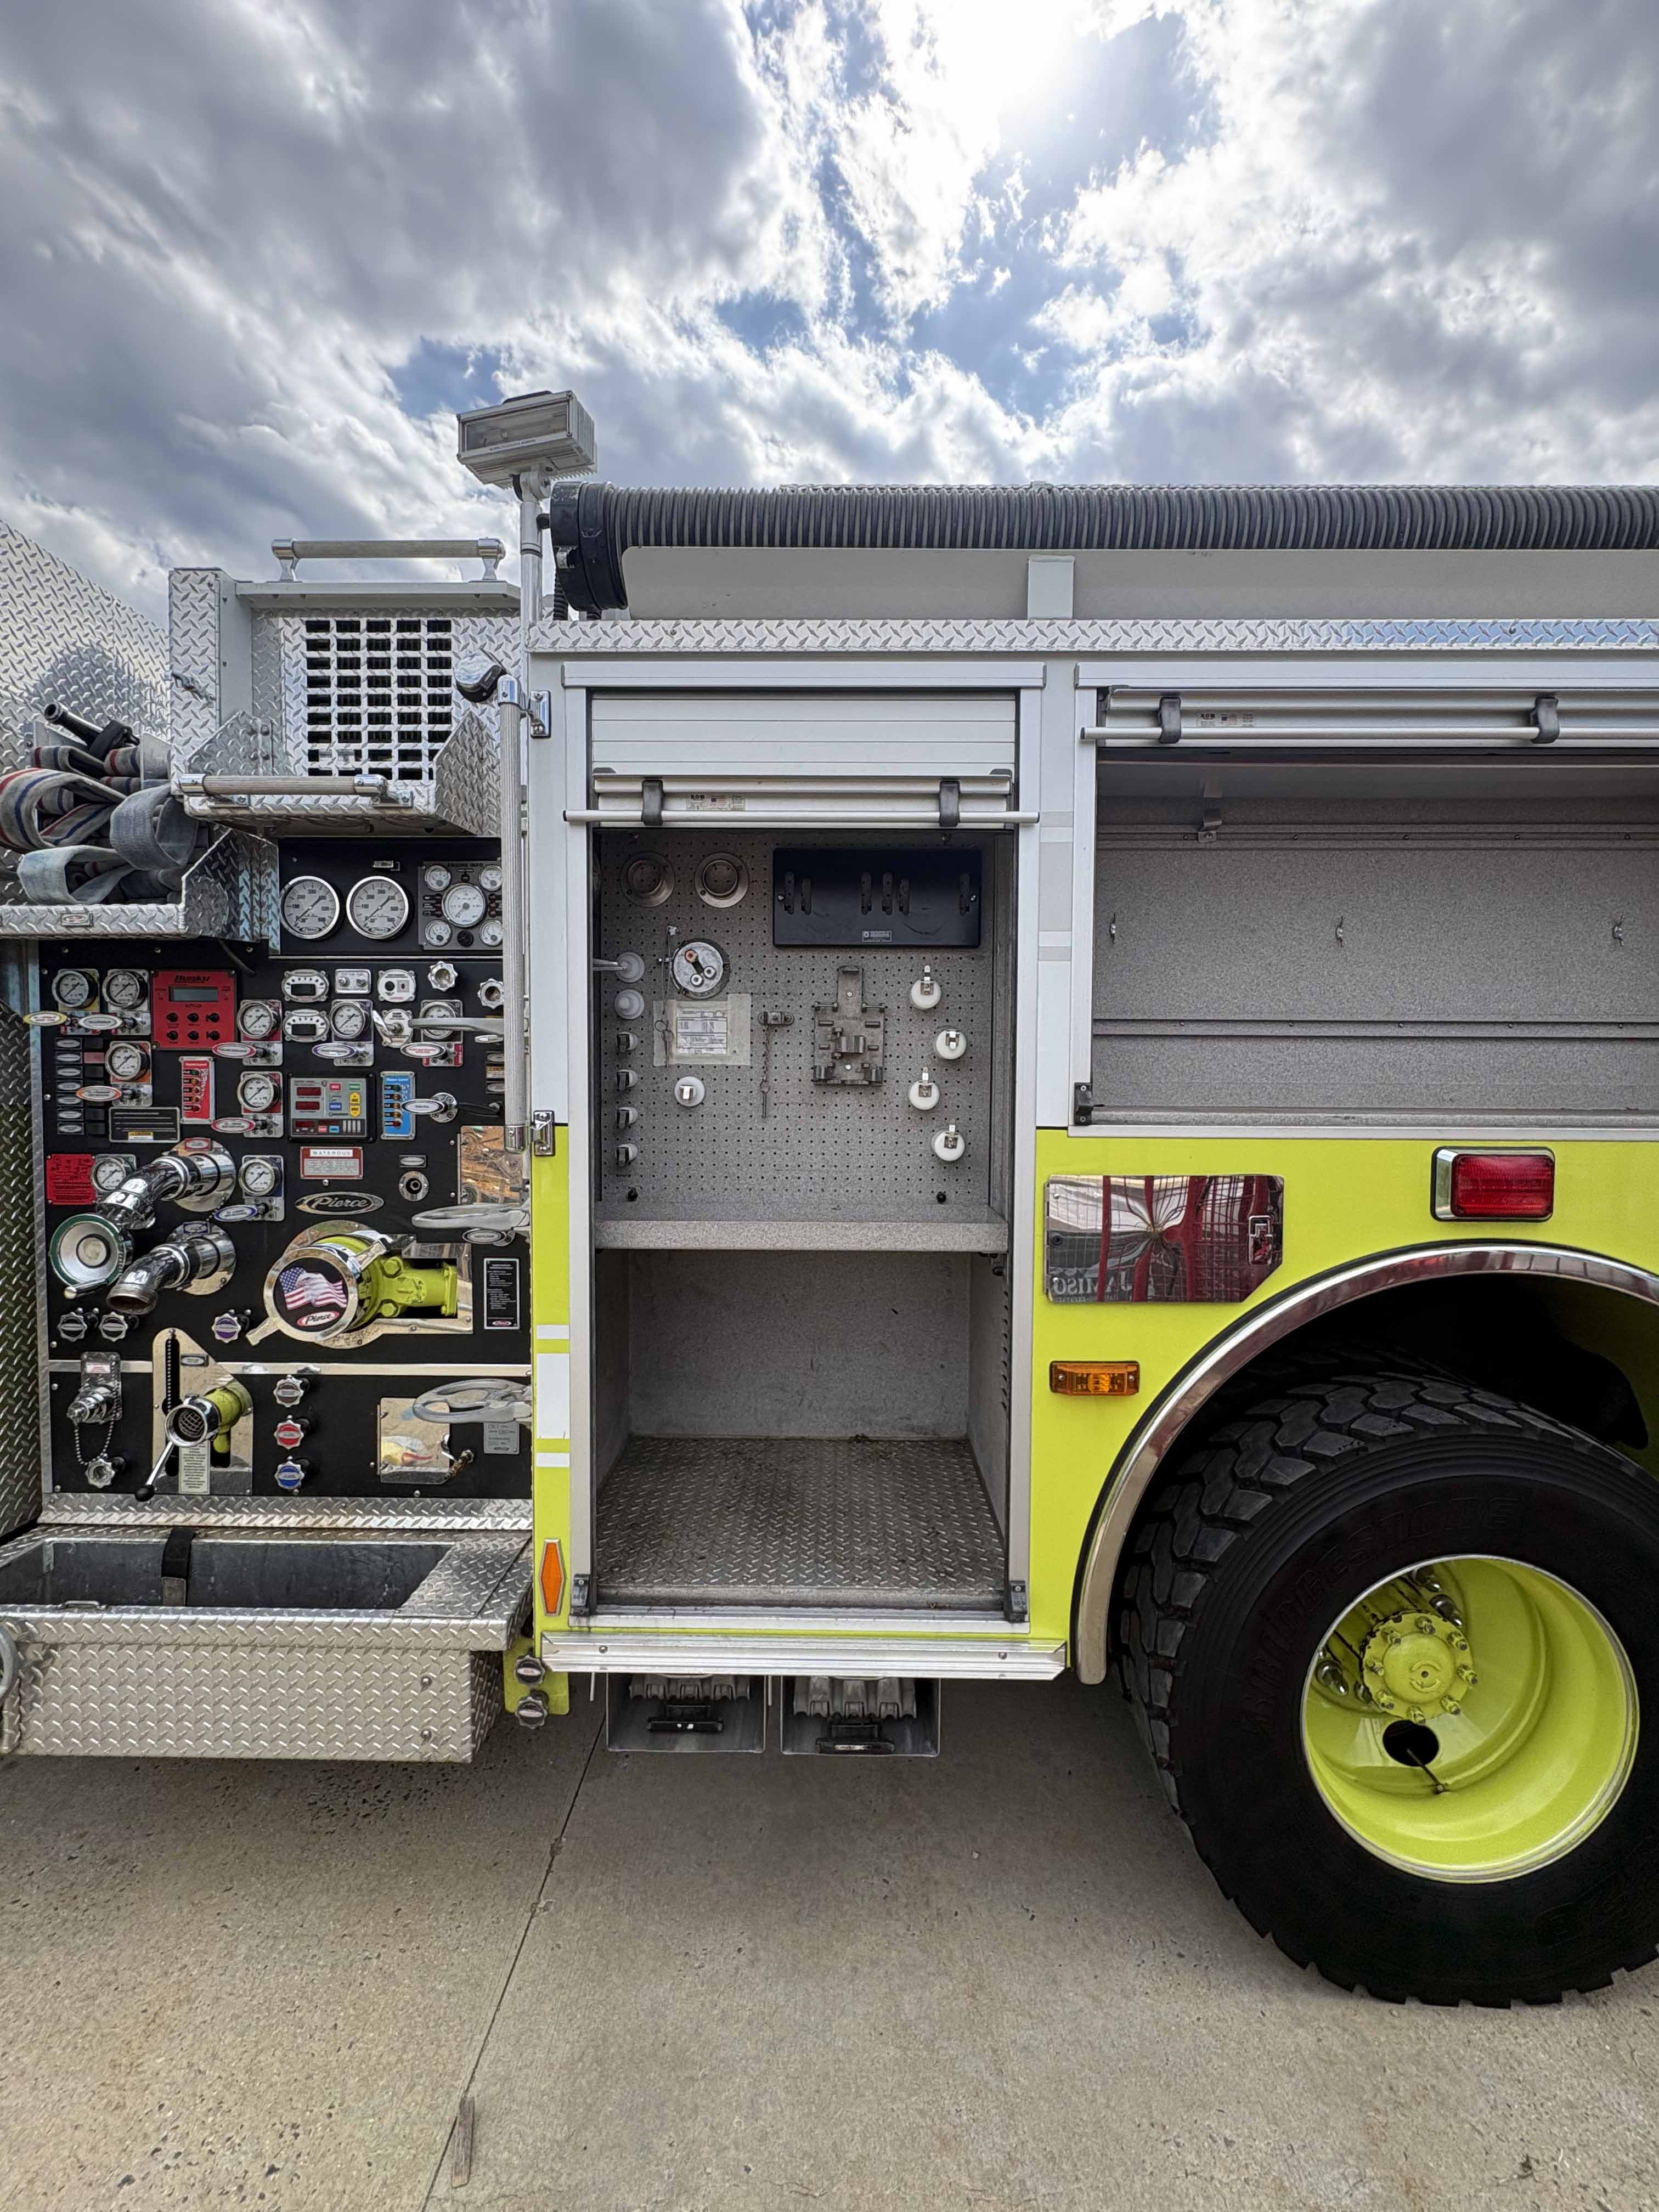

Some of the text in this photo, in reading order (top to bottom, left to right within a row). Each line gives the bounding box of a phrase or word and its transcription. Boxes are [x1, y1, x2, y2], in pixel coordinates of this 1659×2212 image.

[311, 1197, 369, 1209] Pierce
[305, 1313, 331, 1324] Pierce
[1240, 1496, 1523, 1737] BRIDGESTONE
